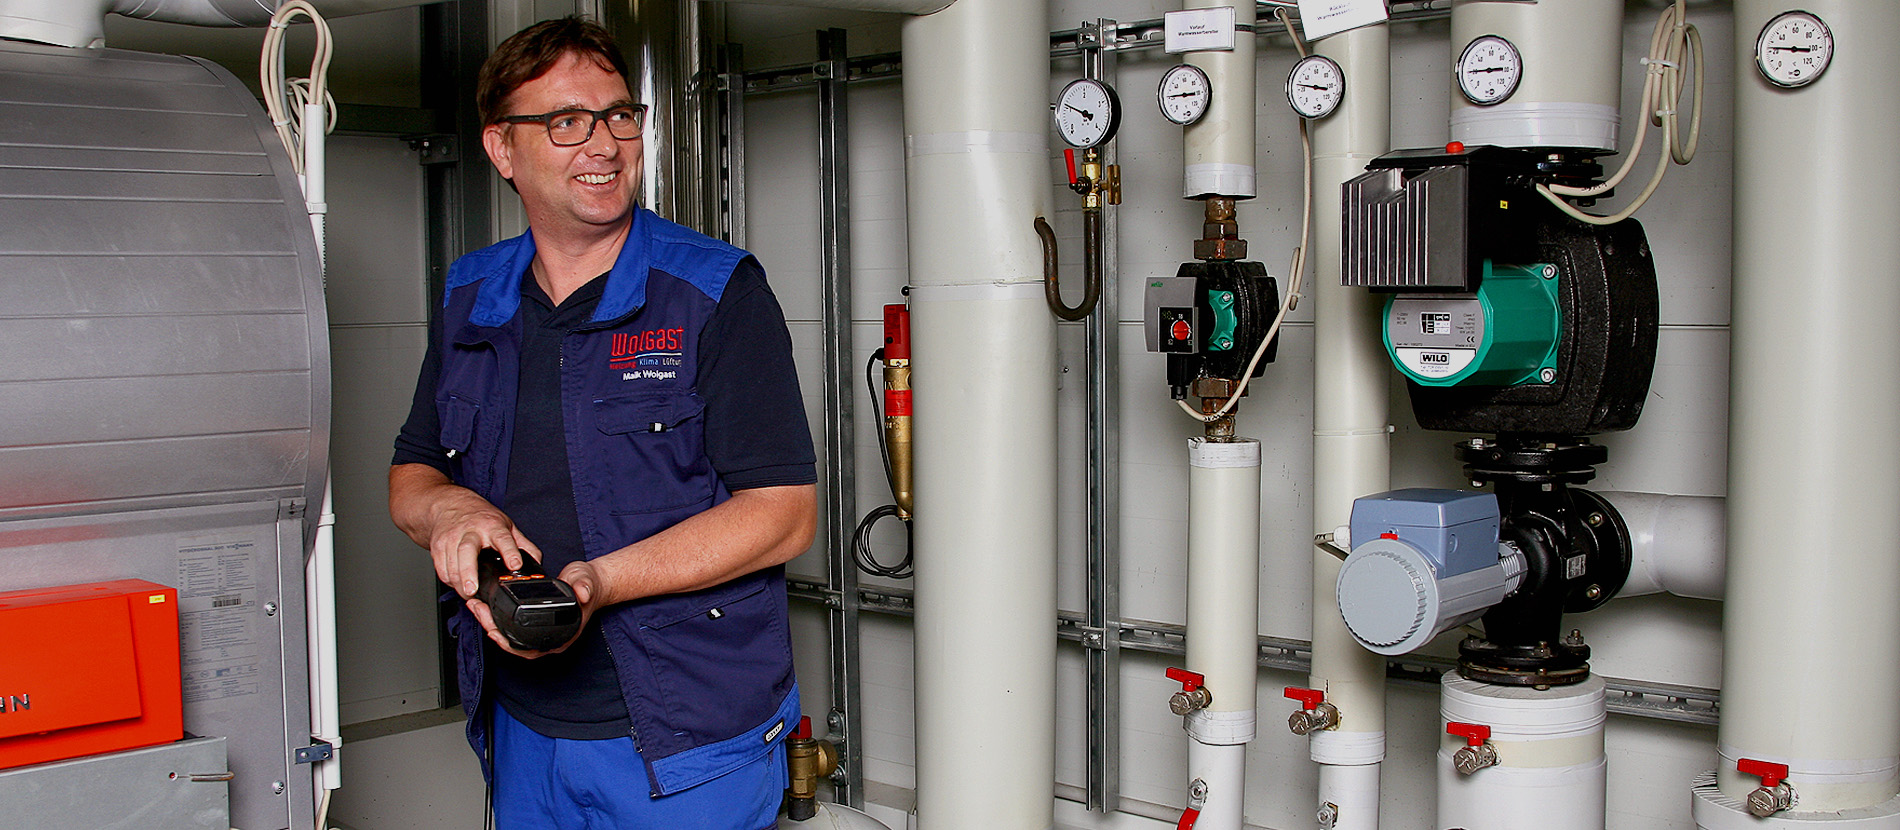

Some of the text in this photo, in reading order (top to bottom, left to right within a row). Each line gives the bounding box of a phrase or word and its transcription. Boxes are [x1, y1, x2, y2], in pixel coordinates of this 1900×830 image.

[1803, 57, 1813, 66] 120
[639, 358, 659, 366] Klima
[623, 370, 676, 380] Maik Wolgast
